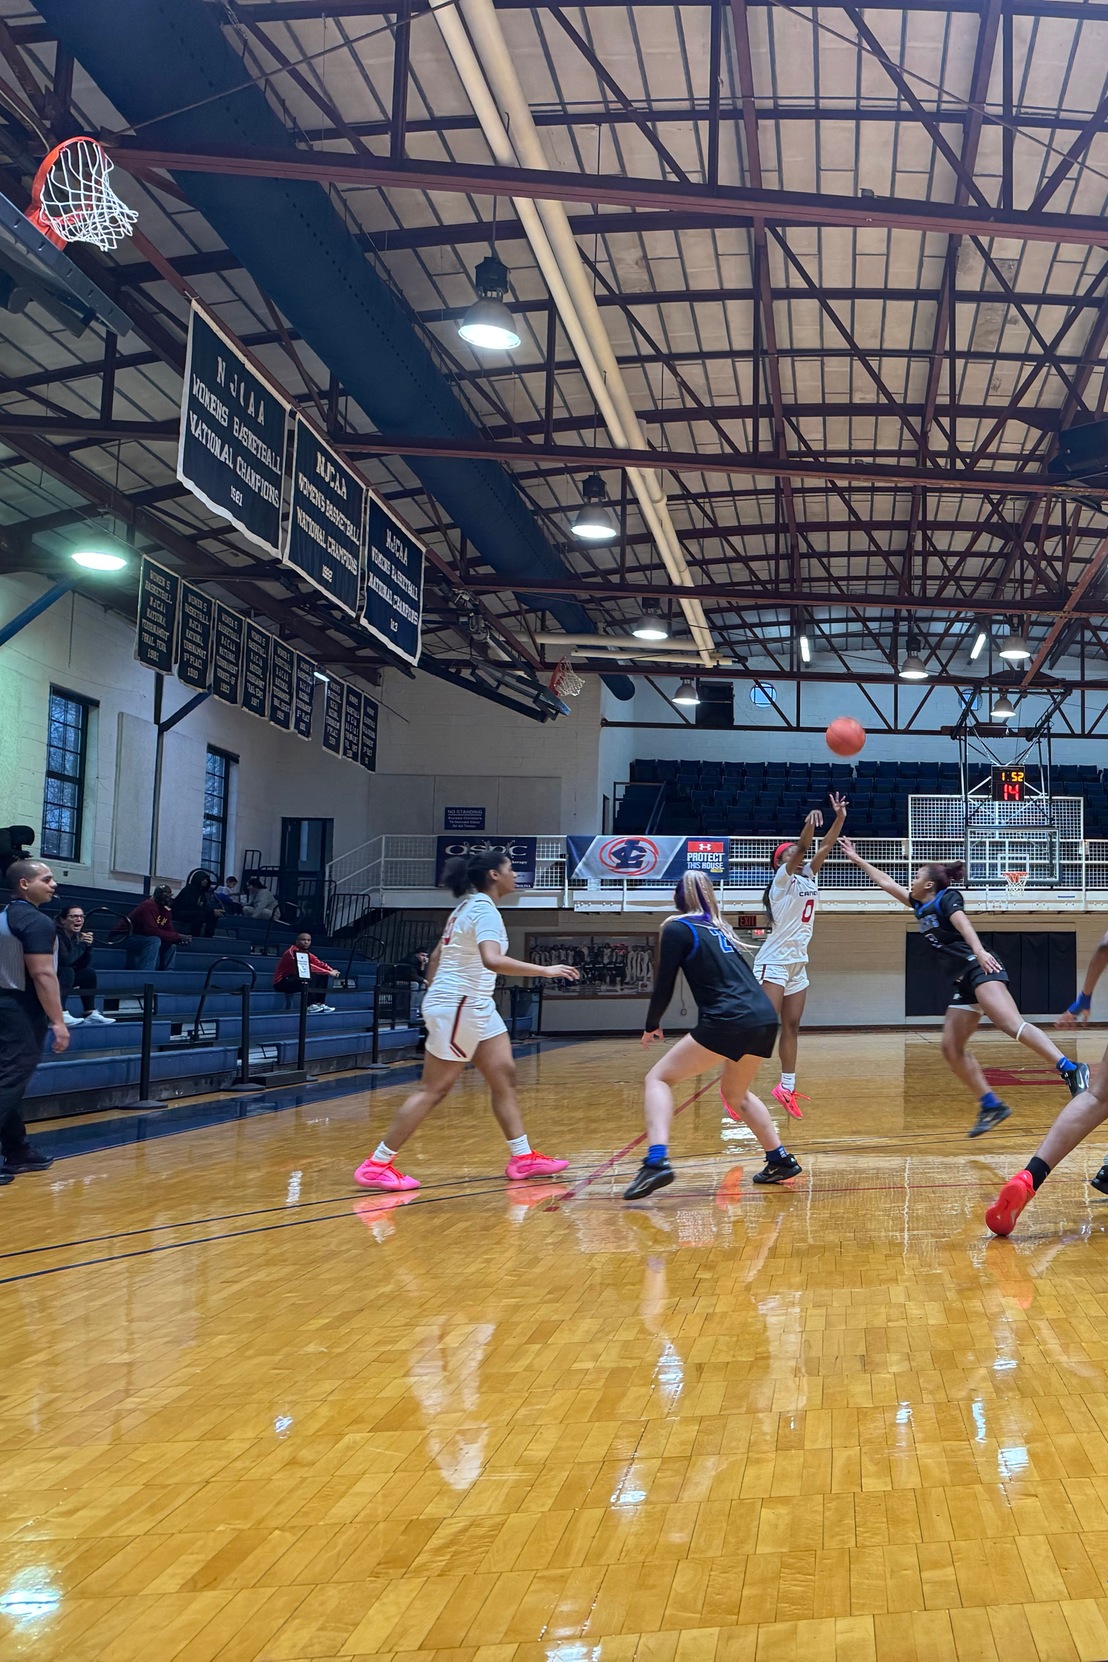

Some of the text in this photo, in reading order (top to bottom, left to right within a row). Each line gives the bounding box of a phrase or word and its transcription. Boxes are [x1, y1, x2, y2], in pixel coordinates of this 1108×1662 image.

[233, 416, 281, 475] BASKETBALL
[190, 410, 280, 508] NATIONAL CHAMPIONS
[326, 499, 360, 545] BASKETBALL
[297, 506, 358, 576] NATIONAL CHAMPIONS
[1003, 783, 1019, 801] 14
[687, 852, 725, 862] PROTECT
[687, 862, 701, 870] THIS
[740, 916, 755, 926] EXIT
[801, 899, 814, 923] 0
